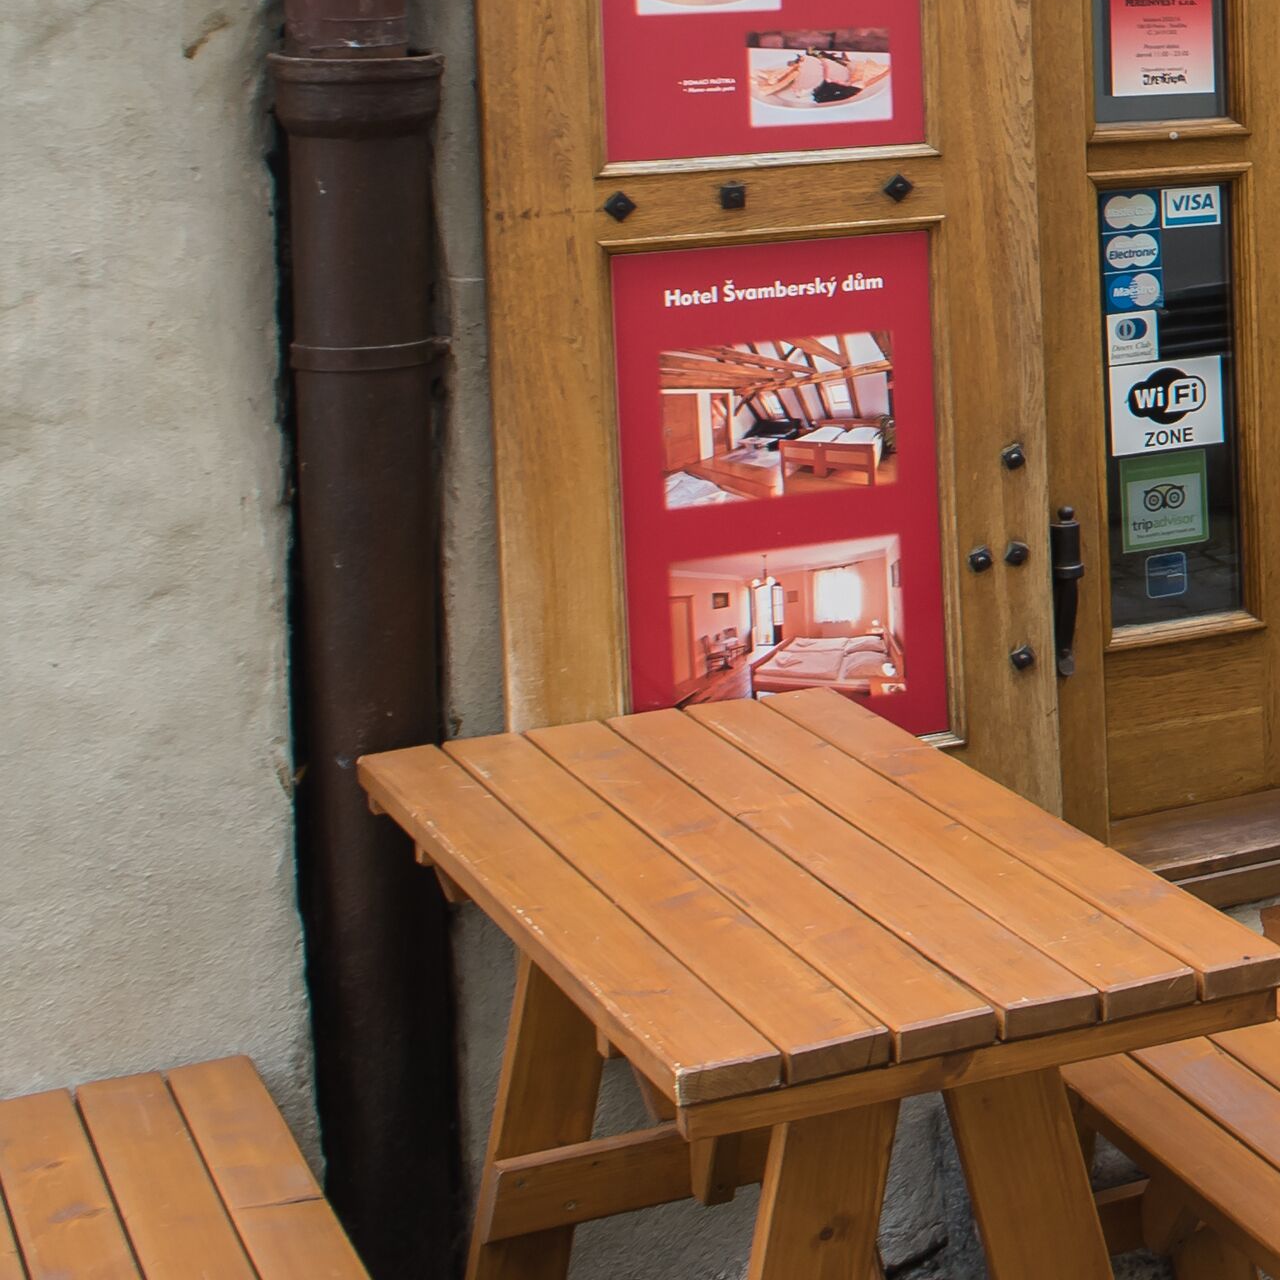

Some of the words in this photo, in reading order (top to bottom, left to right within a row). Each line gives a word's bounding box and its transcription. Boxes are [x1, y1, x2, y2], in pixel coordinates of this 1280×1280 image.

[1172, 193, 1215, 212] VISA
[1108, 247, 1158, 261] Electronic
[664, 286, 718, 308] Hotel
[722, 276, 837, 303] Švamberský
[842, 273, 884, 292] dům
[1112, 286, 1156, 298] Maestro
[1144, 426, 1194, 448] ZONE
[1132, 513, 1196, 533] tripadvisor
